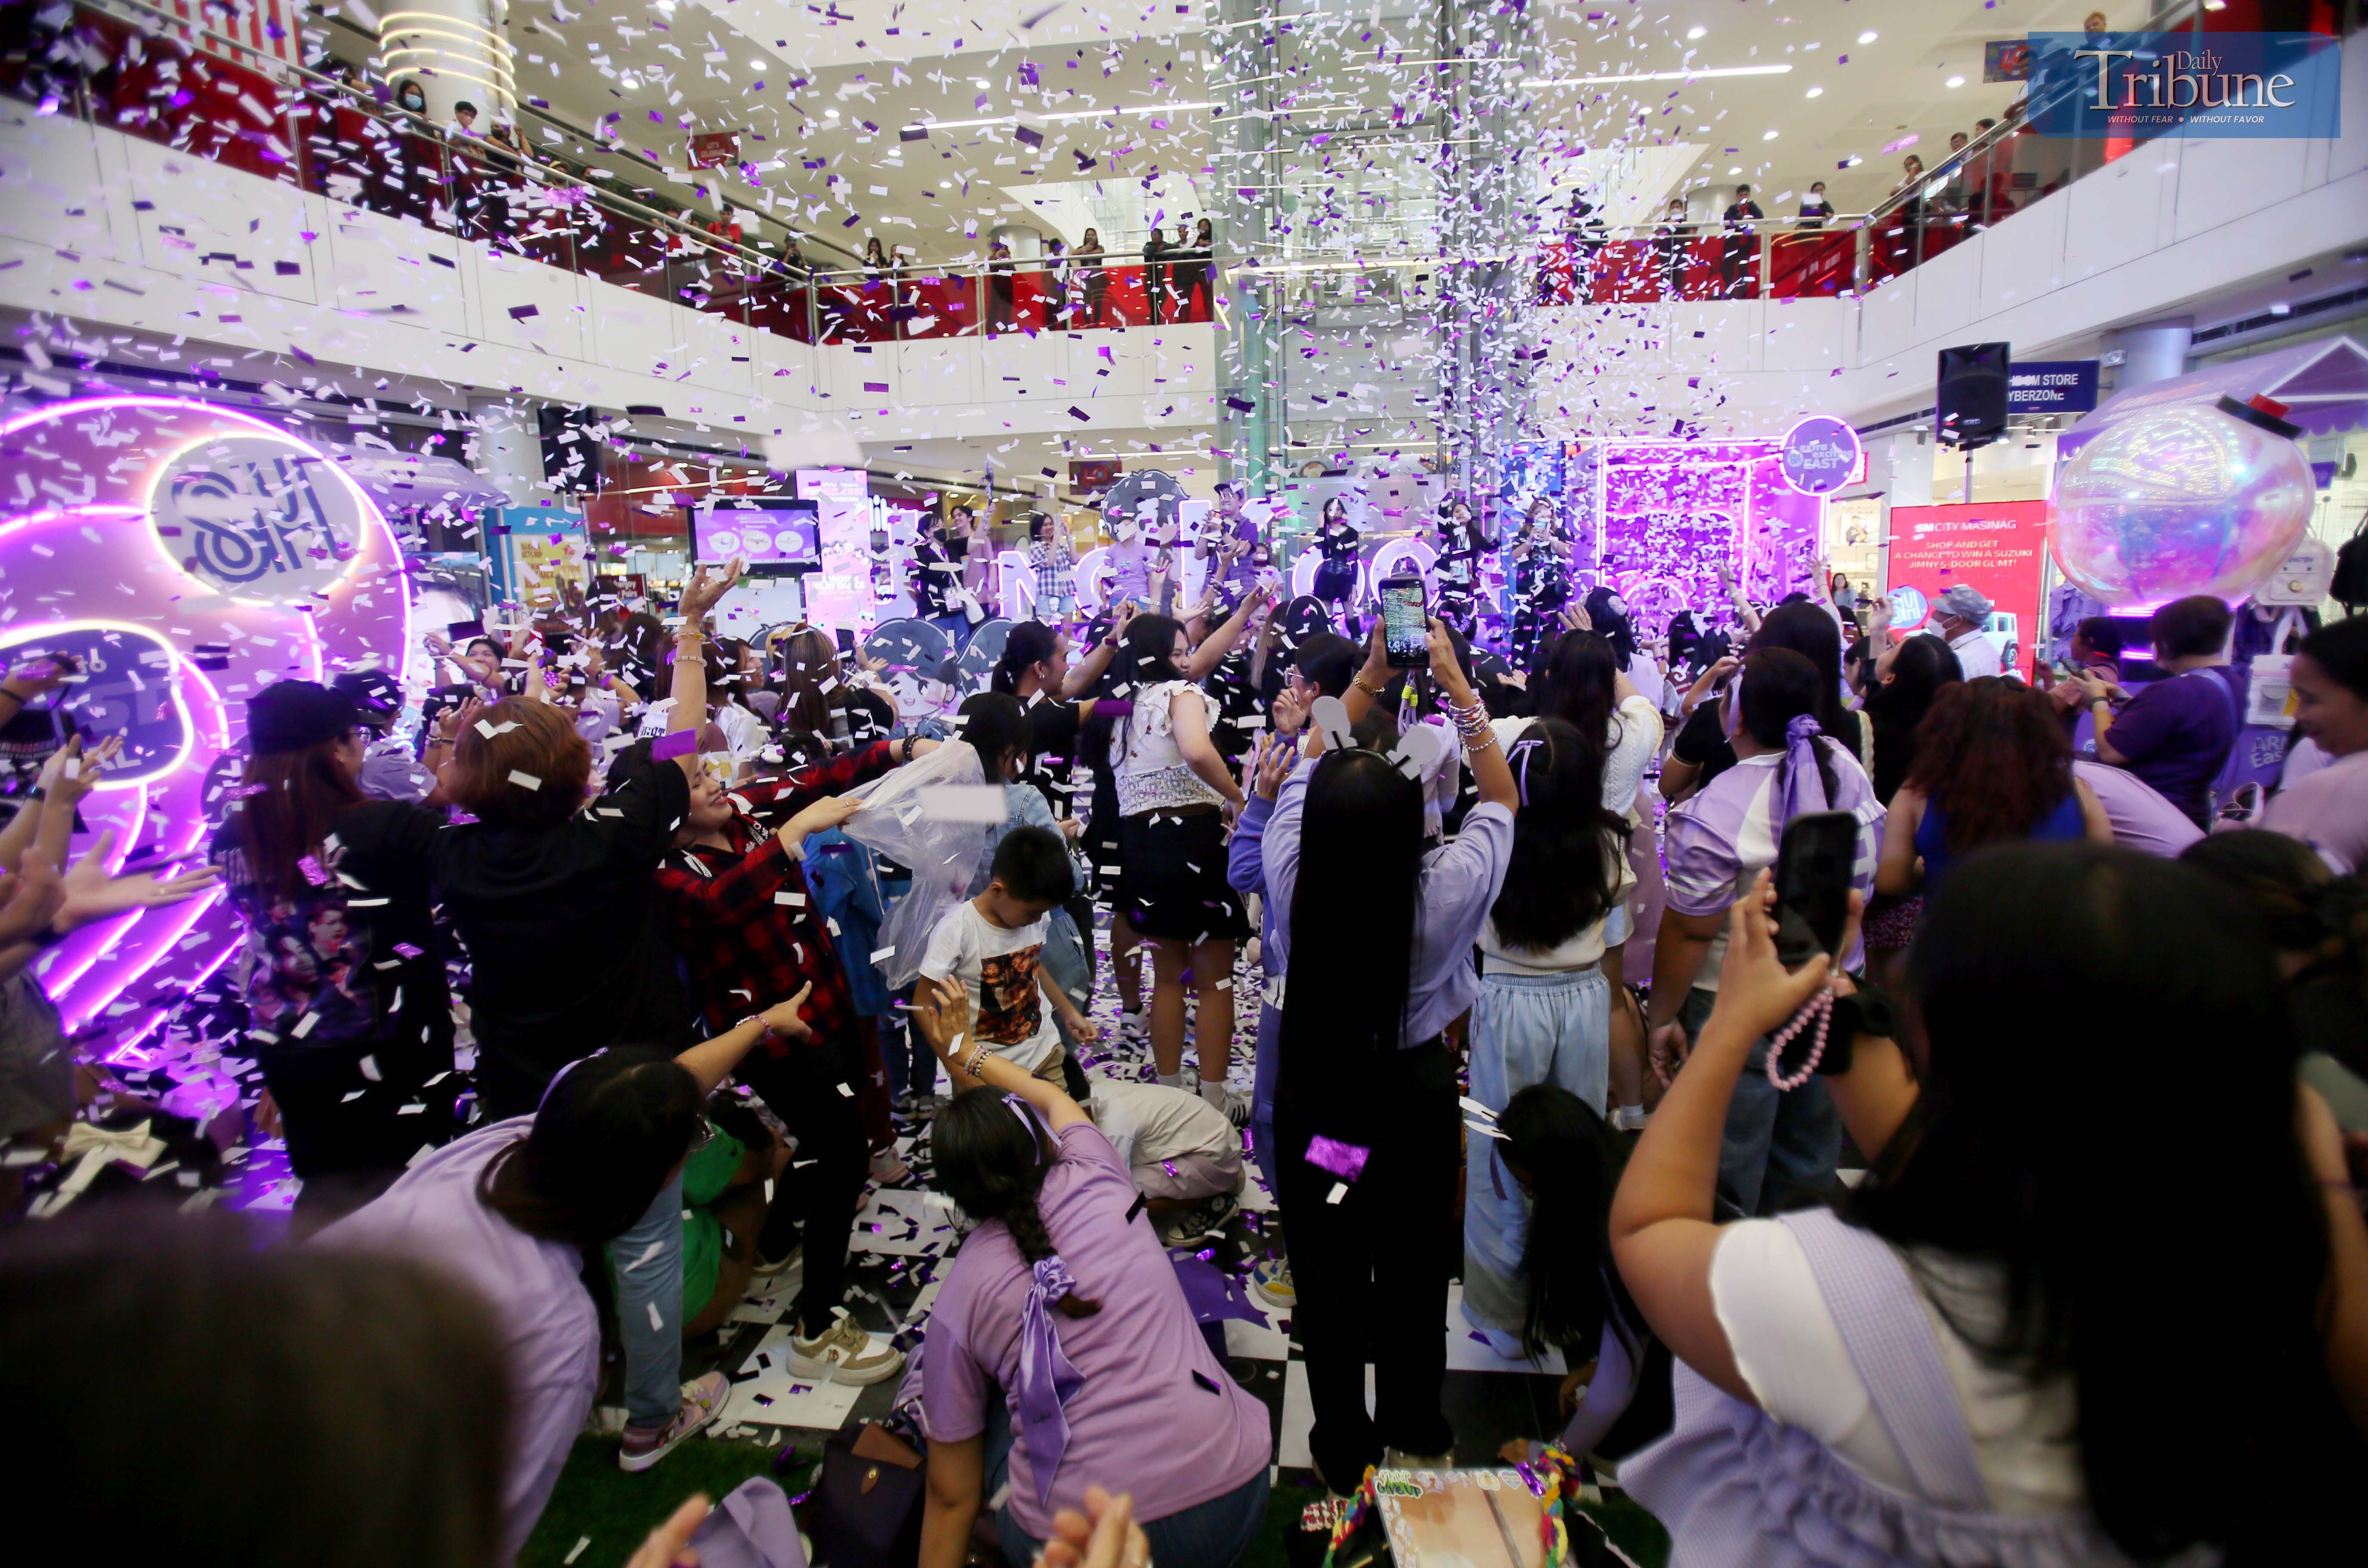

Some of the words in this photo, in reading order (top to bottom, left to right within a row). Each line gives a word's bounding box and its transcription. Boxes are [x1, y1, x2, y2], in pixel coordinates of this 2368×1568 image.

[2043, 373, 2079, 385] STORE
[2008, 389, 2065, 401] YBERZONE
[1803, 457, 1840, 469] EAST
[1915, 523, 1934, 533] SM
[1935, 522, 1959, 532] CITY
[1955, 540, 1977, 548] AND
[1979, 539, 1999, 548] GET
[1985, 550, 1992, 558] A
[1995, 549, 2033, 558] SUZUKI
[2251, 750, 2282, 768] Eas
